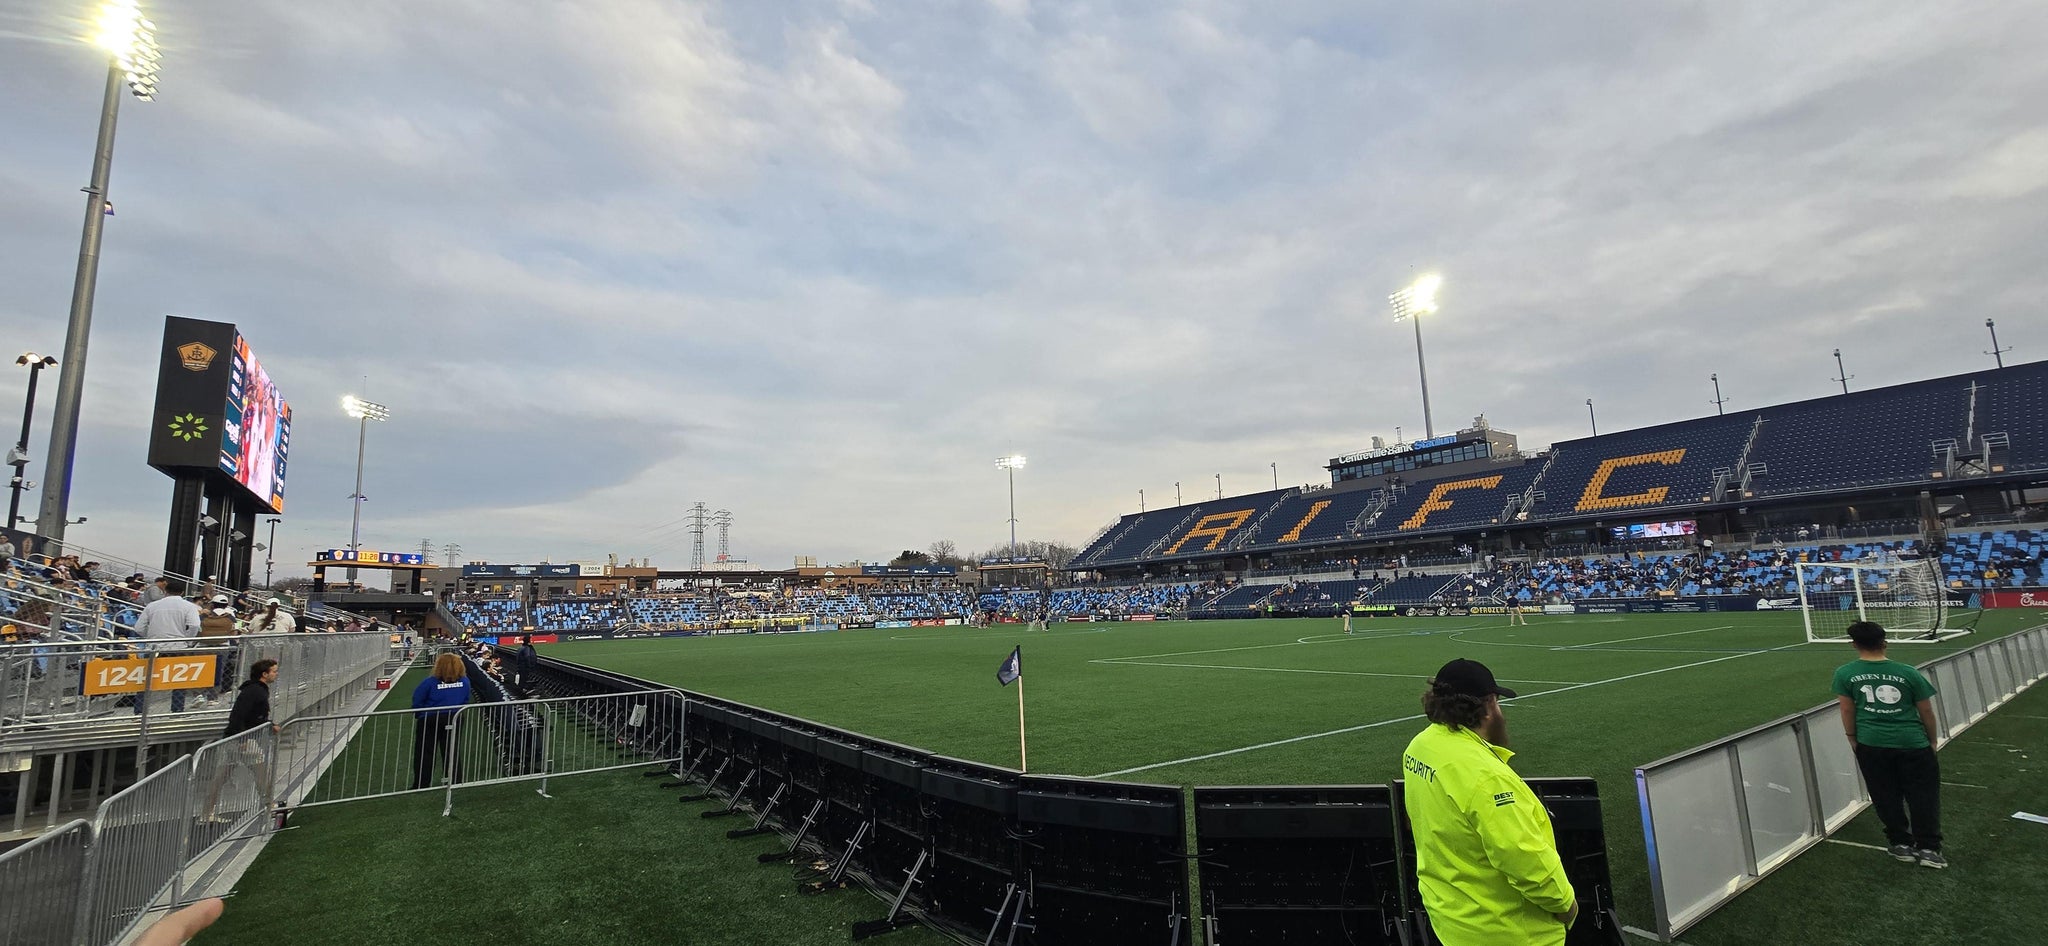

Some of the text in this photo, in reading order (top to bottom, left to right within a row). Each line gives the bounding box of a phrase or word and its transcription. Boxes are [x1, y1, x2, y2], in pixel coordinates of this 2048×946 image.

[1414, 435, 1457, 450] Stadium
[1855, 600, 1964, 608] RODEISLANDFC.COM/TCKETS
[97, 662, 206, 687] 124-127
[1850, 673, 1906, 683] GREEN LINE
[1405, 754, 1436, 783] ECURITY
[1494, 791, 1514, 800] BEST
